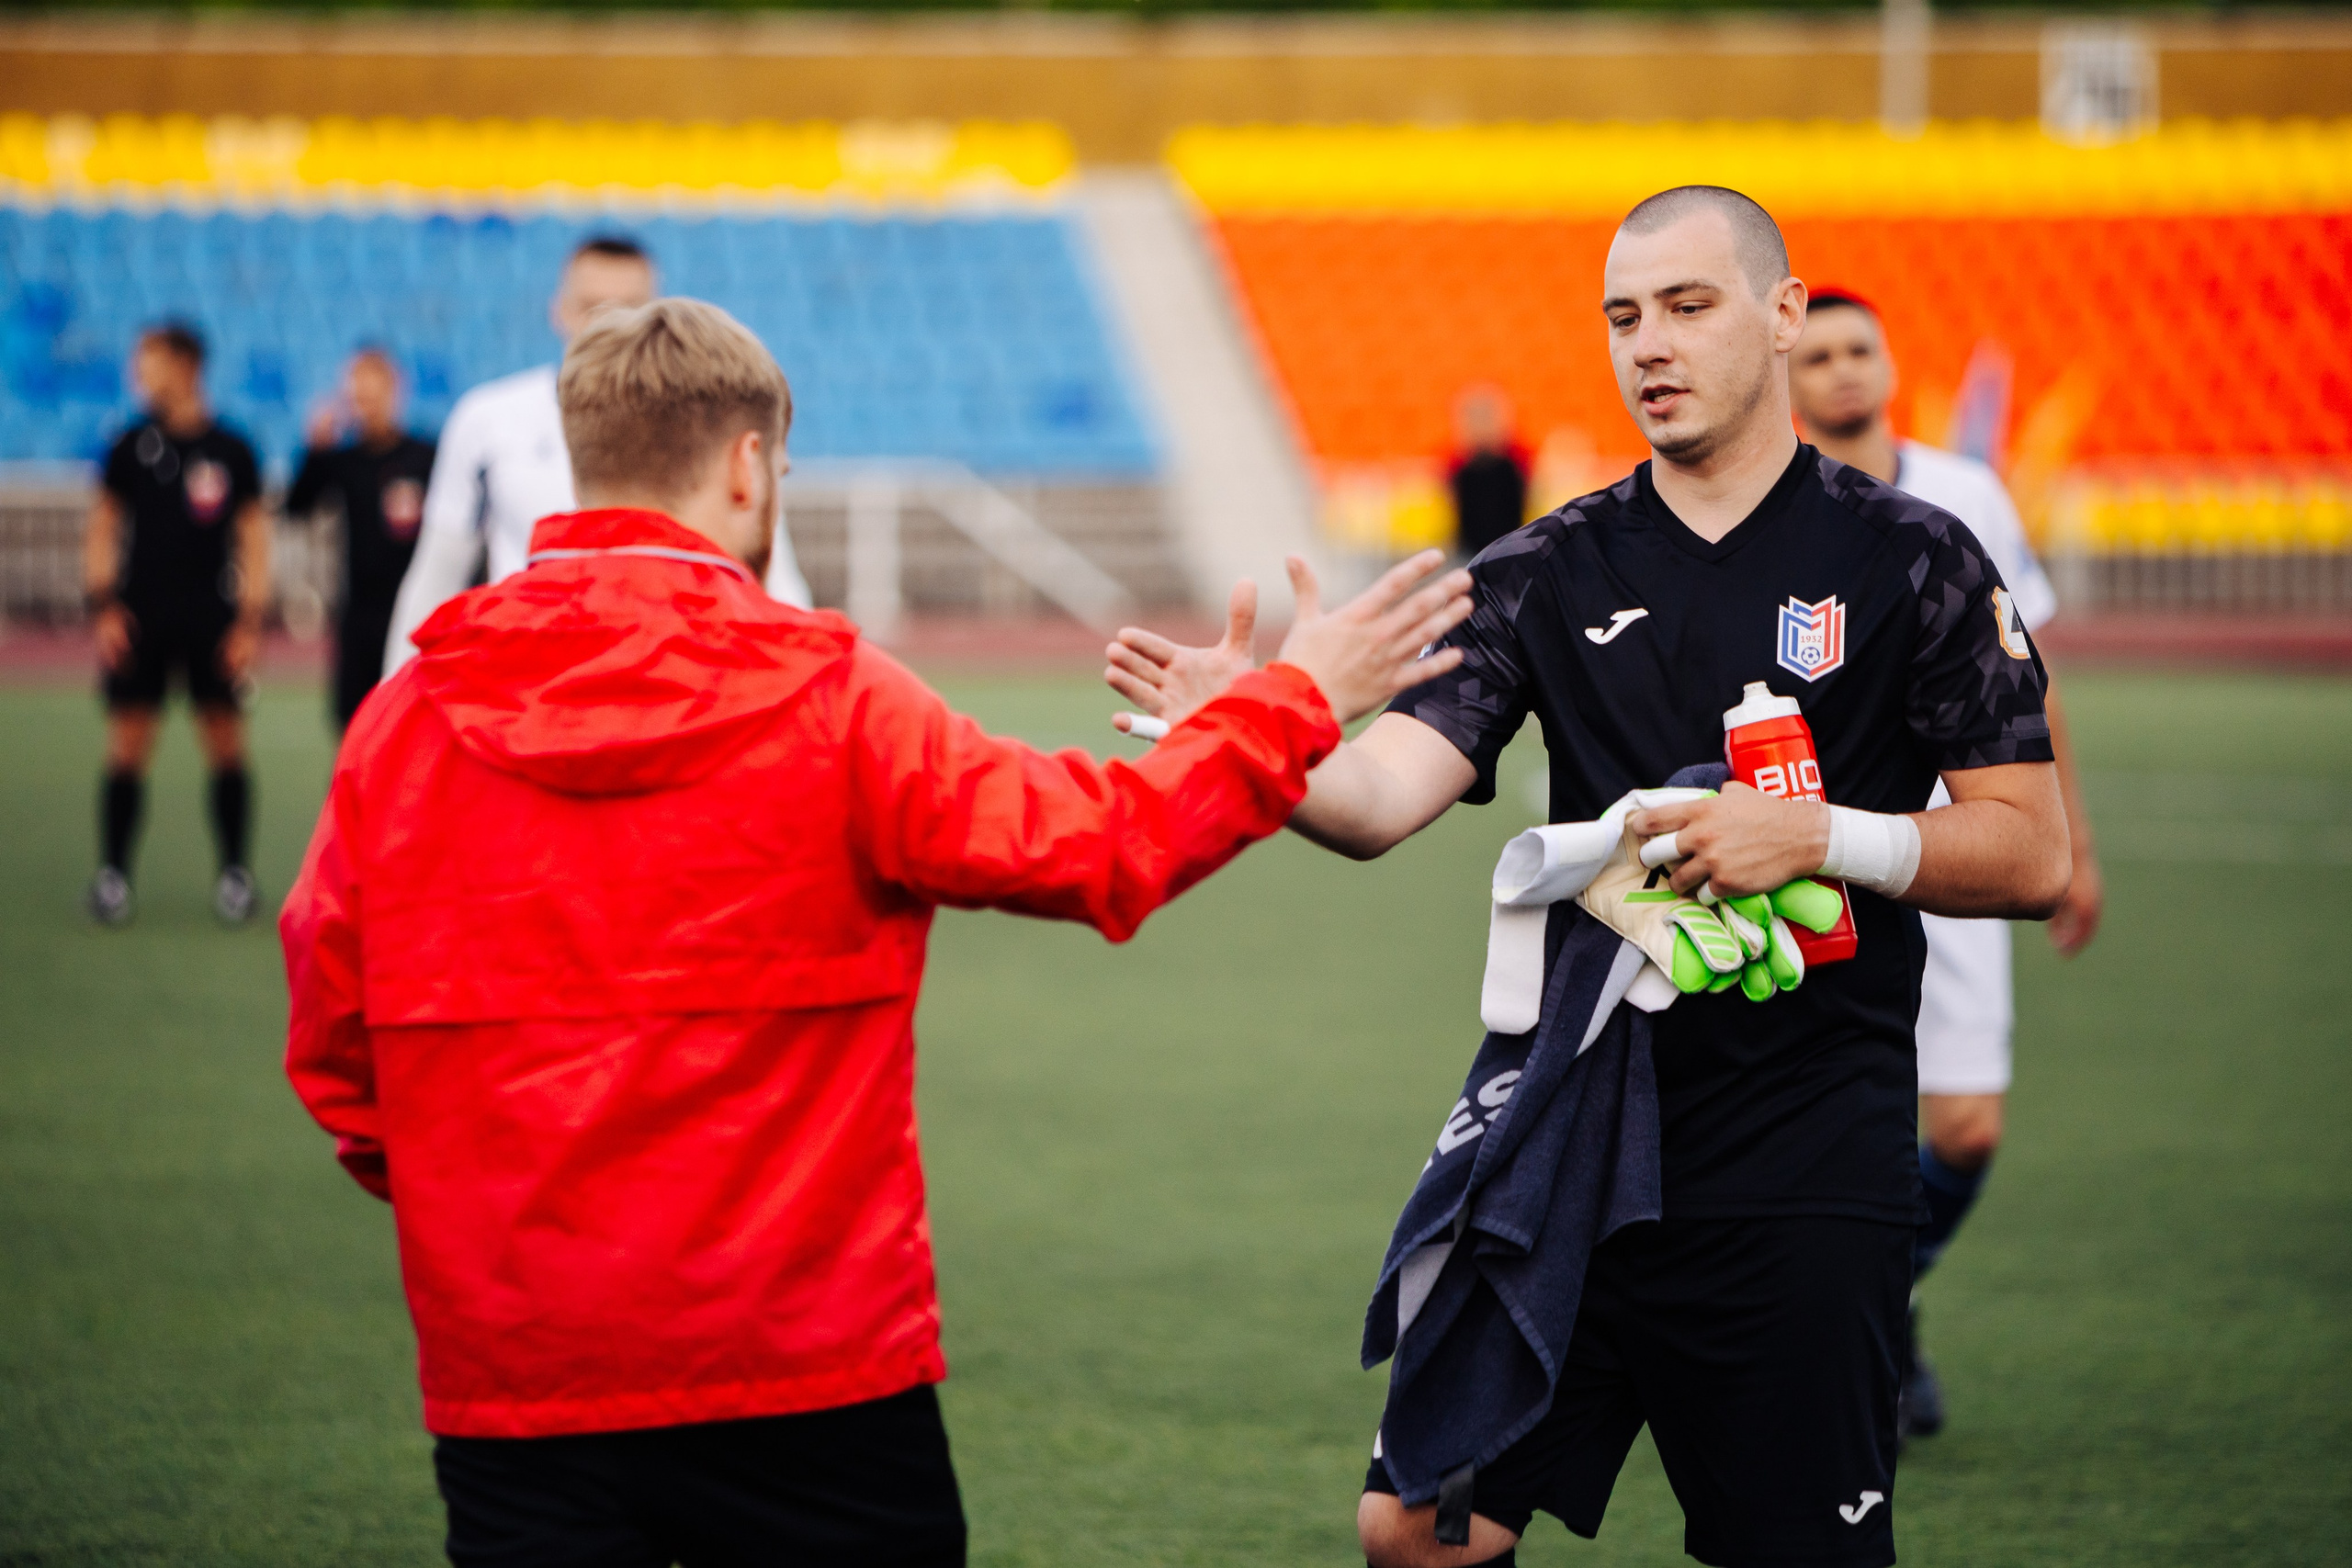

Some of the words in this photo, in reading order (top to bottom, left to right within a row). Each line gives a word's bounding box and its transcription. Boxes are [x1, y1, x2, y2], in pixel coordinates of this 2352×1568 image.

[1801, 635, 1823, 643] 1932
[1754, 759, 1822, 799] BIO
[1423, 1069, 1522, 1175] ES
